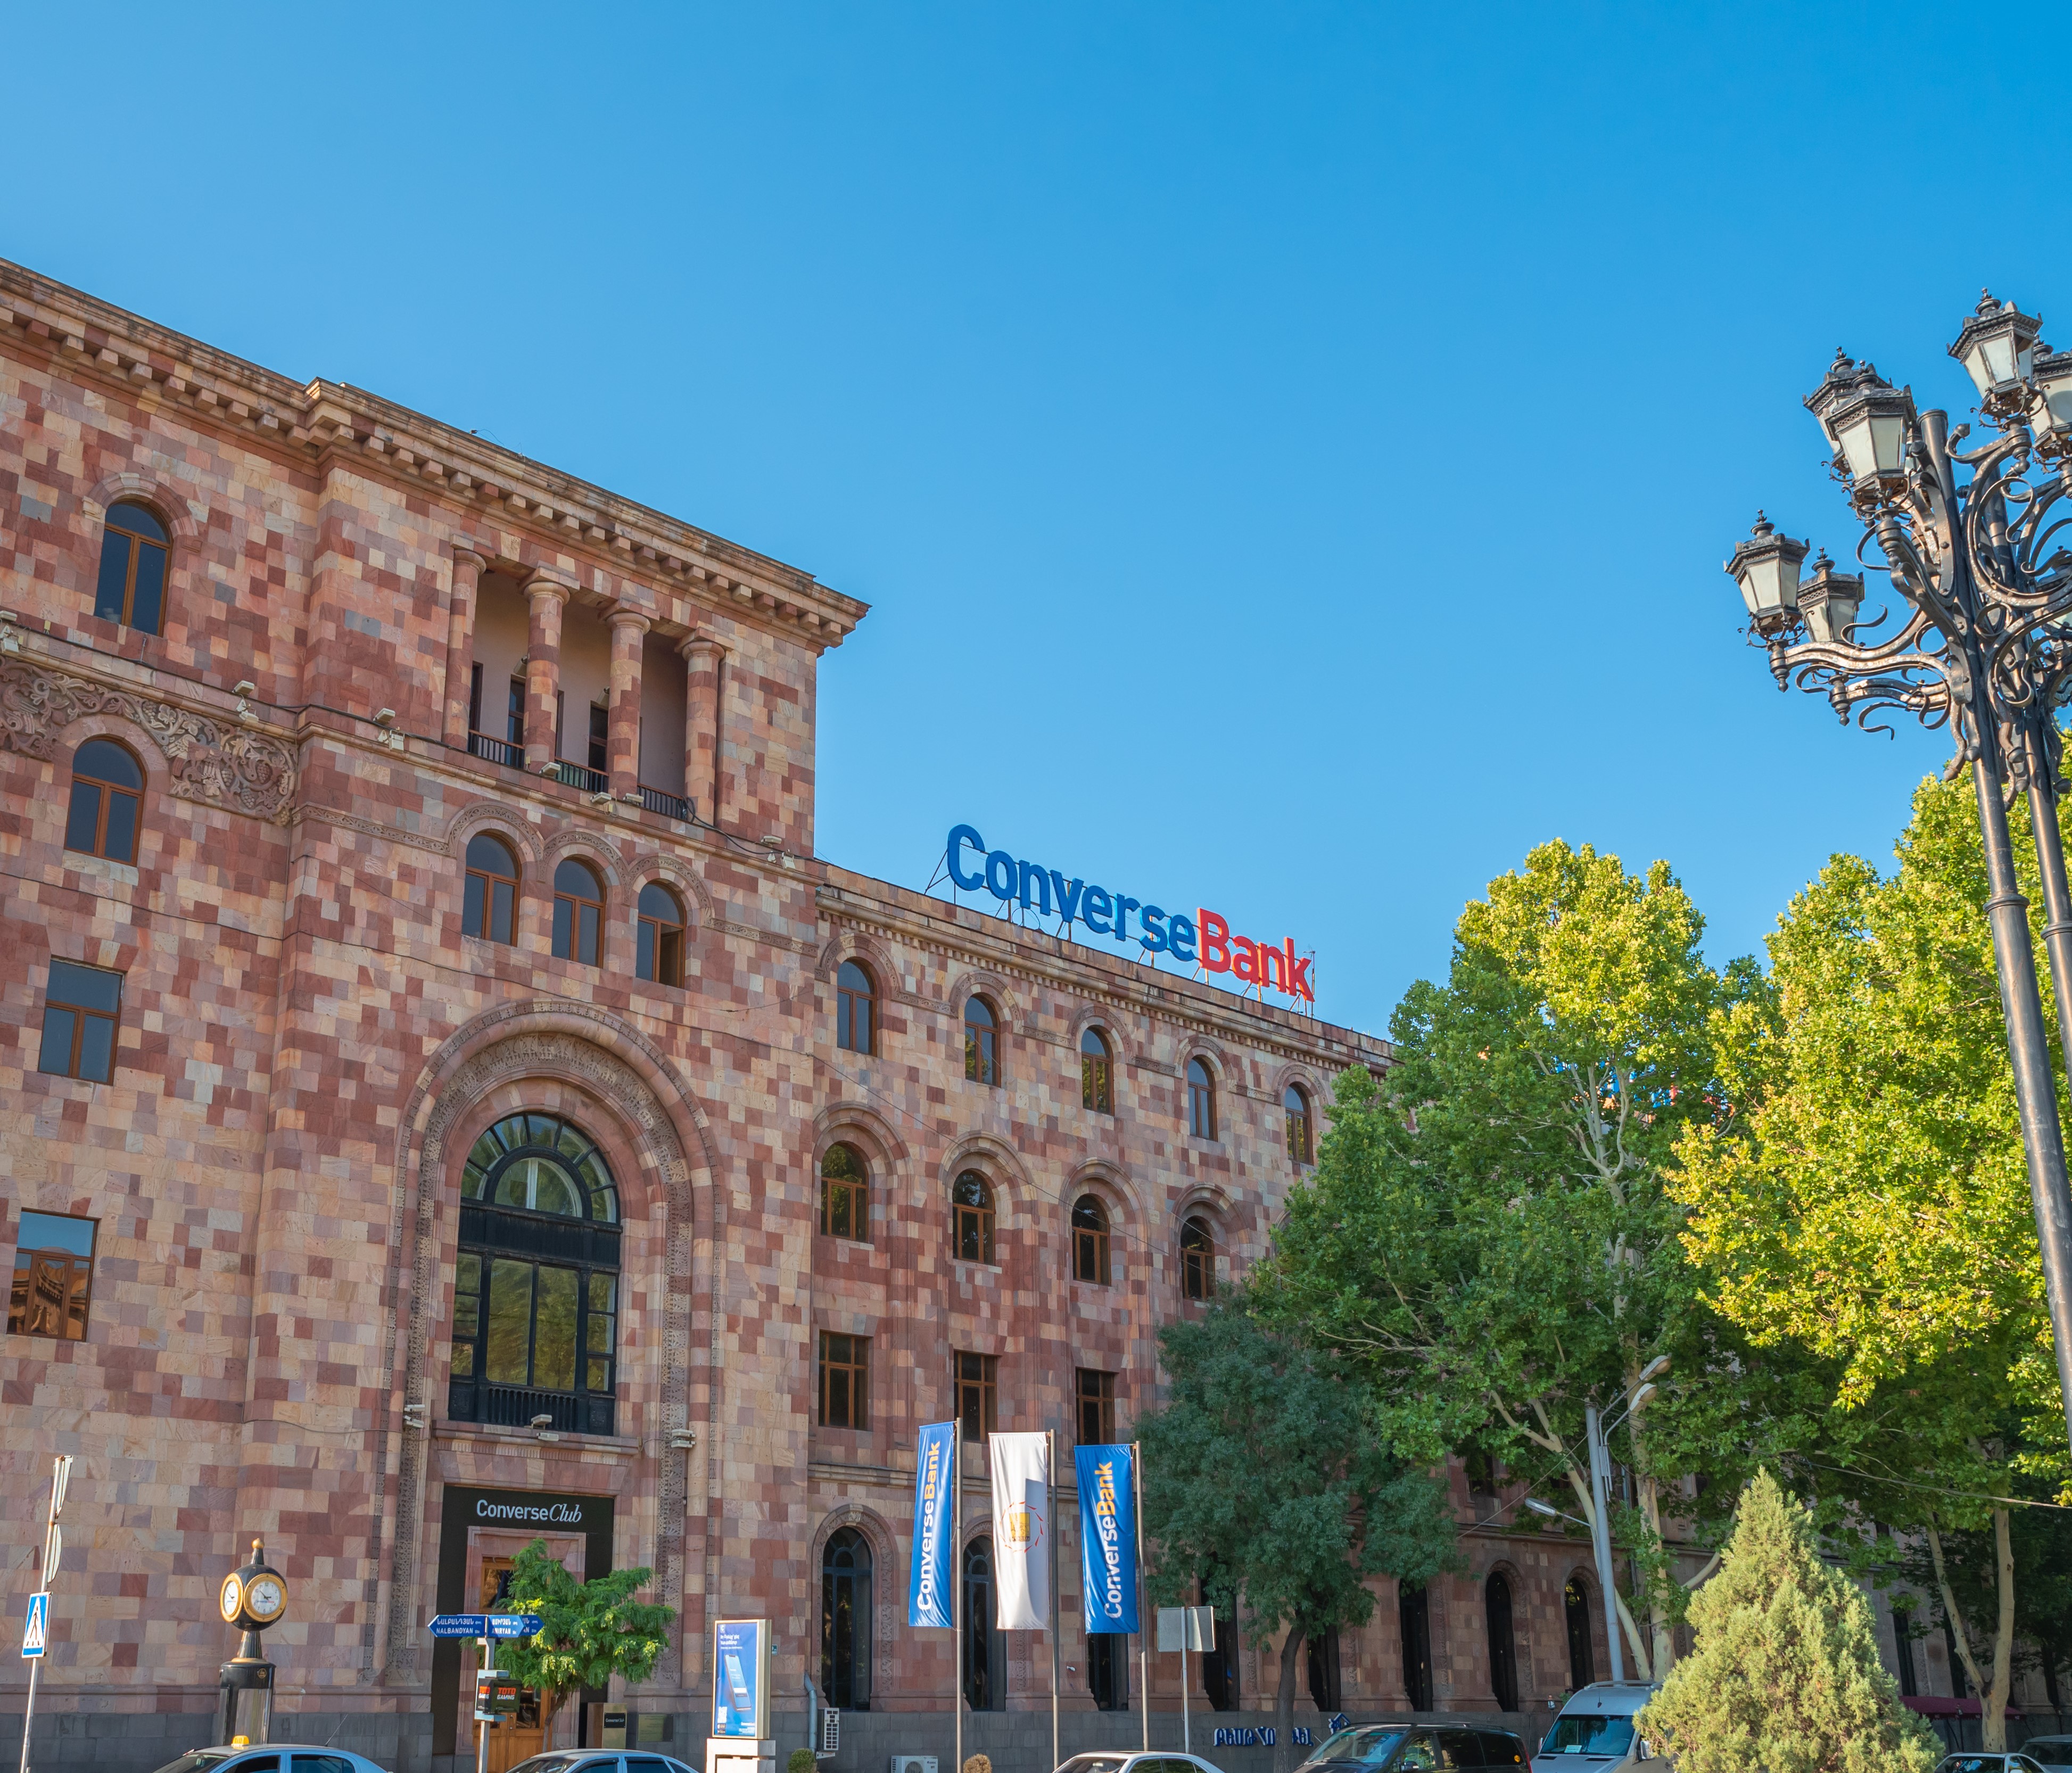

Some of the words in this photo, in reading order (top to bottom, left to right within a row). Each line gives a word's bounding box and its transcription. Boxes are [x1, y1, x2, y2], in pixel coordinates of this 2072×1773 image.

[947, 823, 1315, 1003] ConverseBank
[917, 1440, 940, 1611] ConverseBank
[1094, 1461, 1122, 1619] ConverseBank
